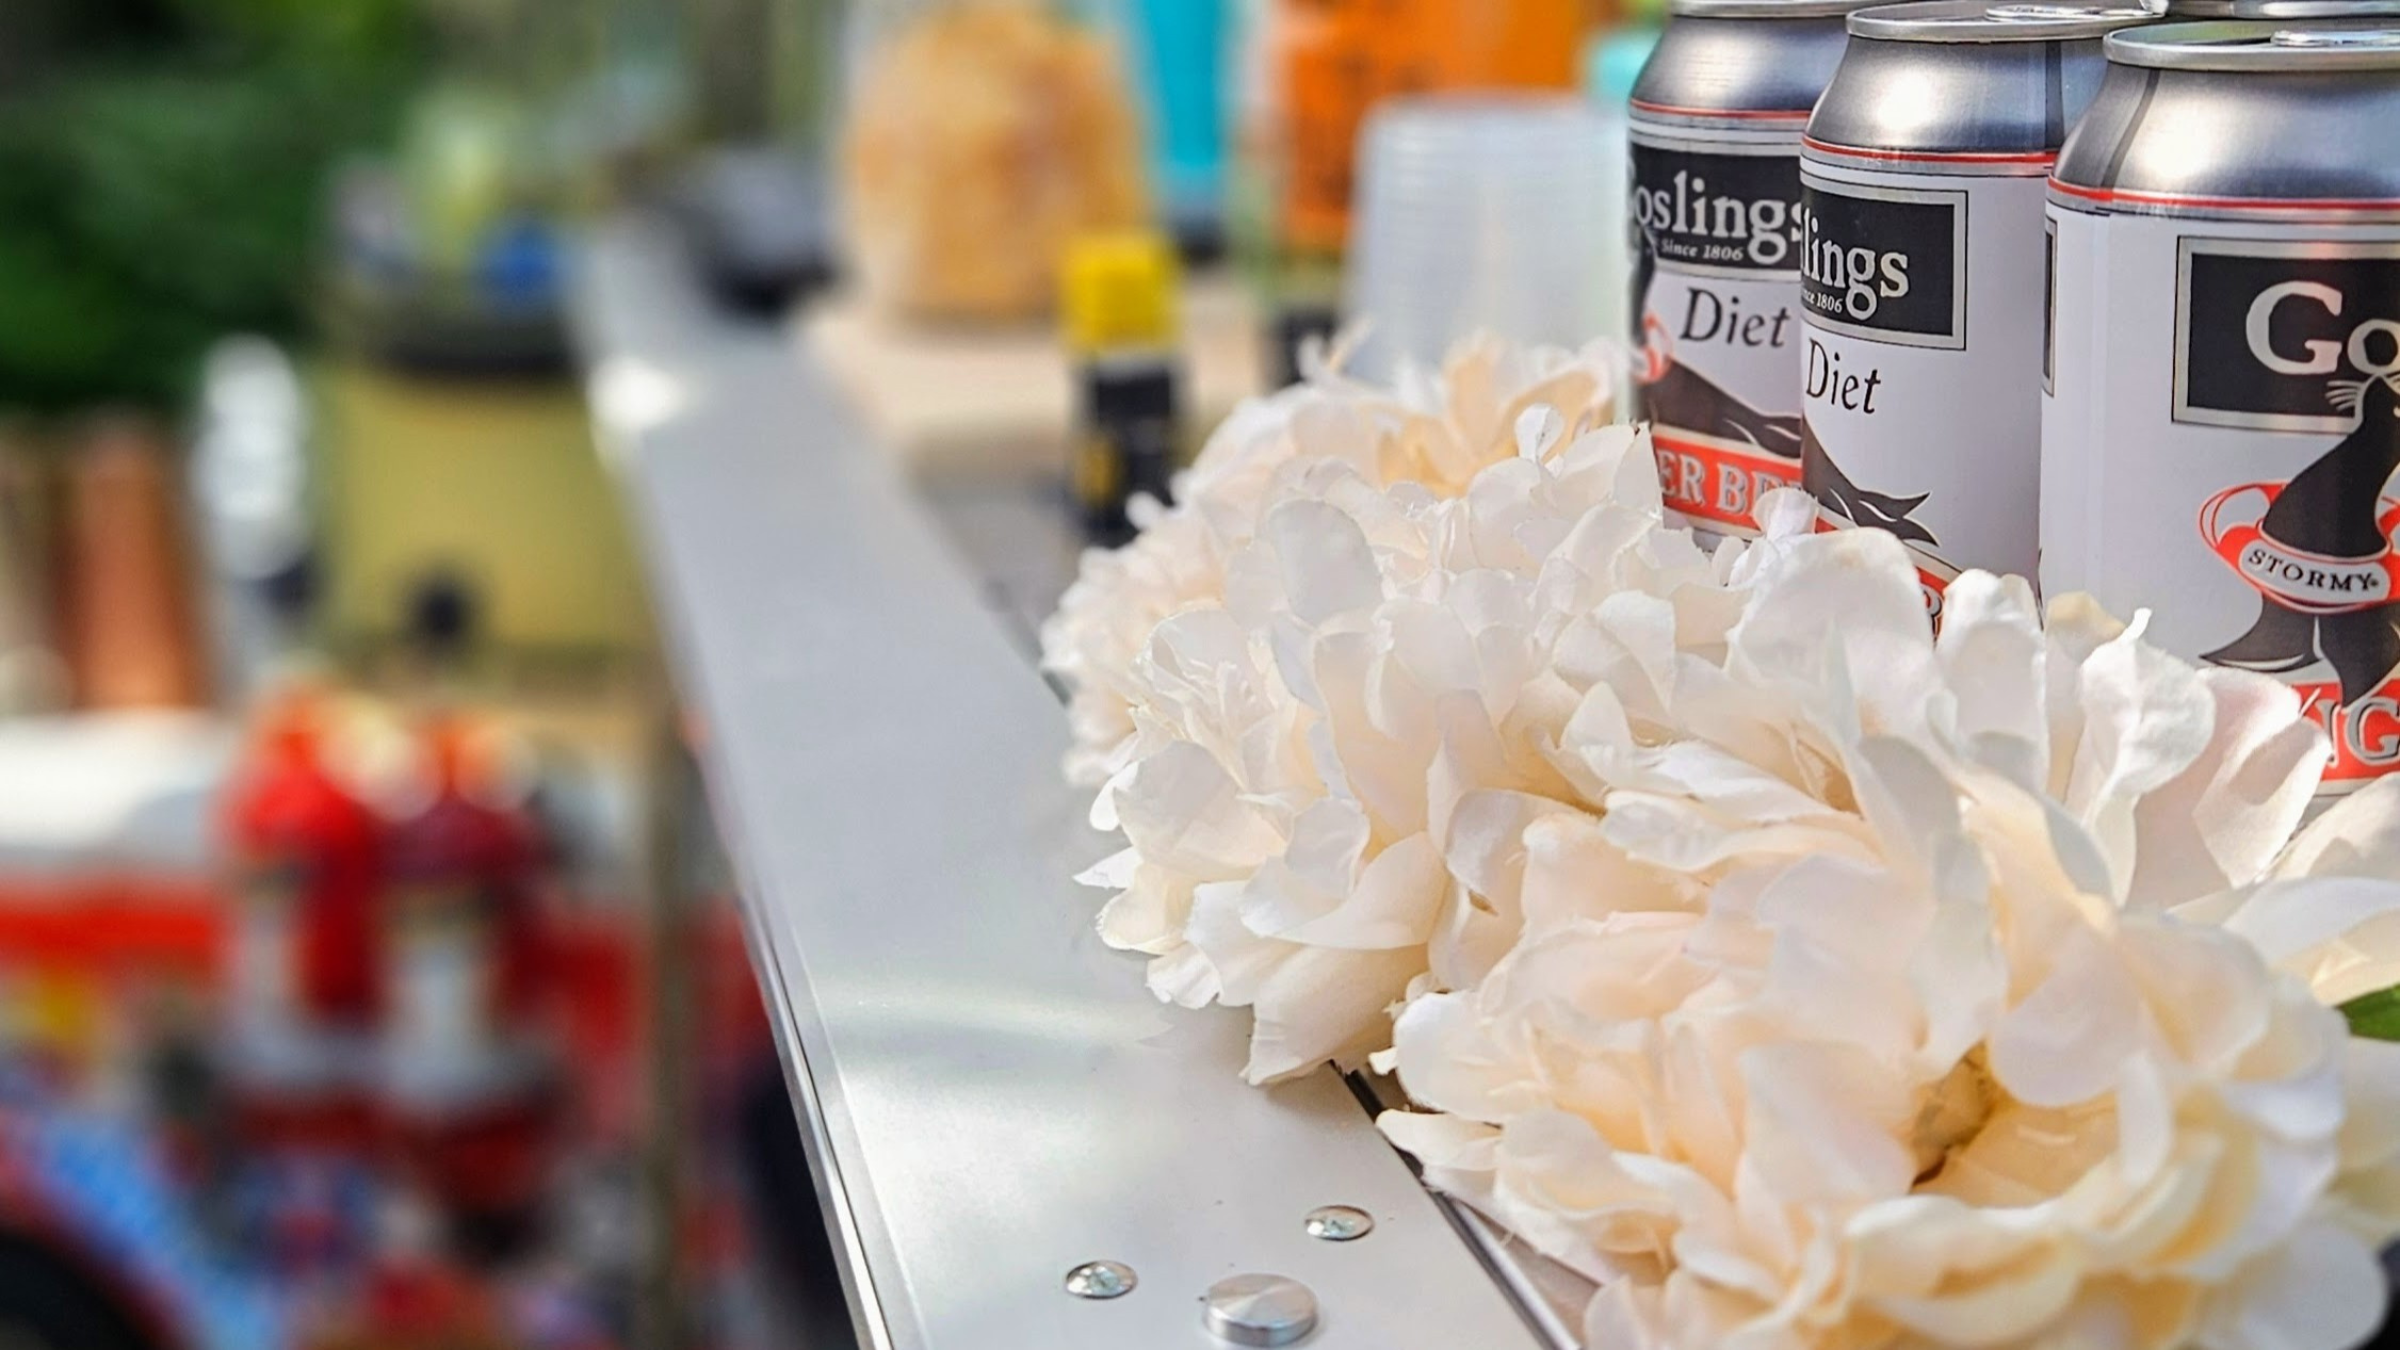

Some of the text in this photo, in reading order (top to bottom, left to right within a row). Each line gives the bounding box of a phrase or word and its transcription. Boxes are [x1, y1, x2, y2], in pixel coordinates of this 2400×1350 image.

[1627, 169, 1801, 265] osling
[1661, 238, 1744, 261] Since 1806
[1678, 286, 1791, 348] Diet
[1817, 291, 1844, 313] 1806
[2245, 280, 2400, 375] Go
[1806, 337, 1881, 415] Diet
